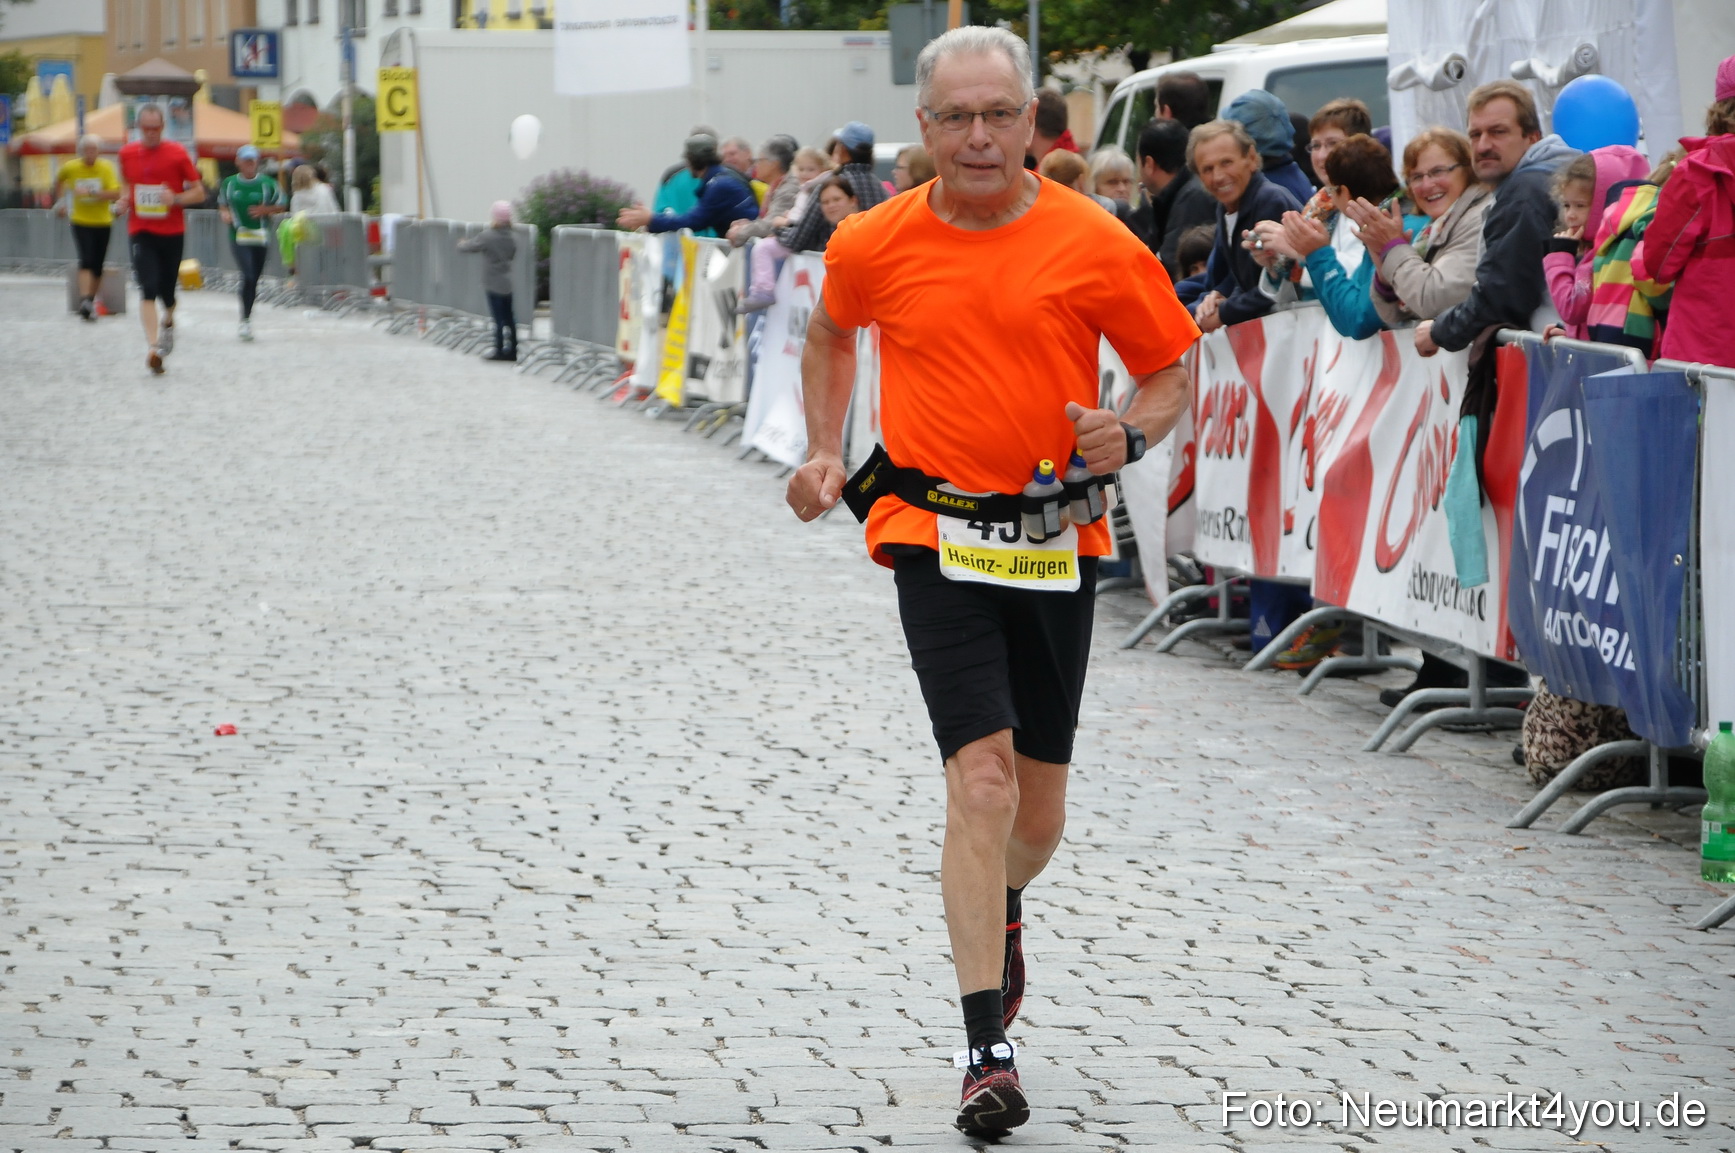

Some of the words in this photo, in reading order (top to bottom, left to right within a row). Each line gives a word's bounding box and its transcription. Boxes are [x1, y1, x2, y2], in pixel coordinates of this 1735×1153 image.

[386, 86, 408, 117] C
[257, 114, 274, 137] D
[938, 495, 976, 510] ALEX
[947, 547, 1003, 574] Heinz-
[1008, 555, 1069, 579] Jürgen
